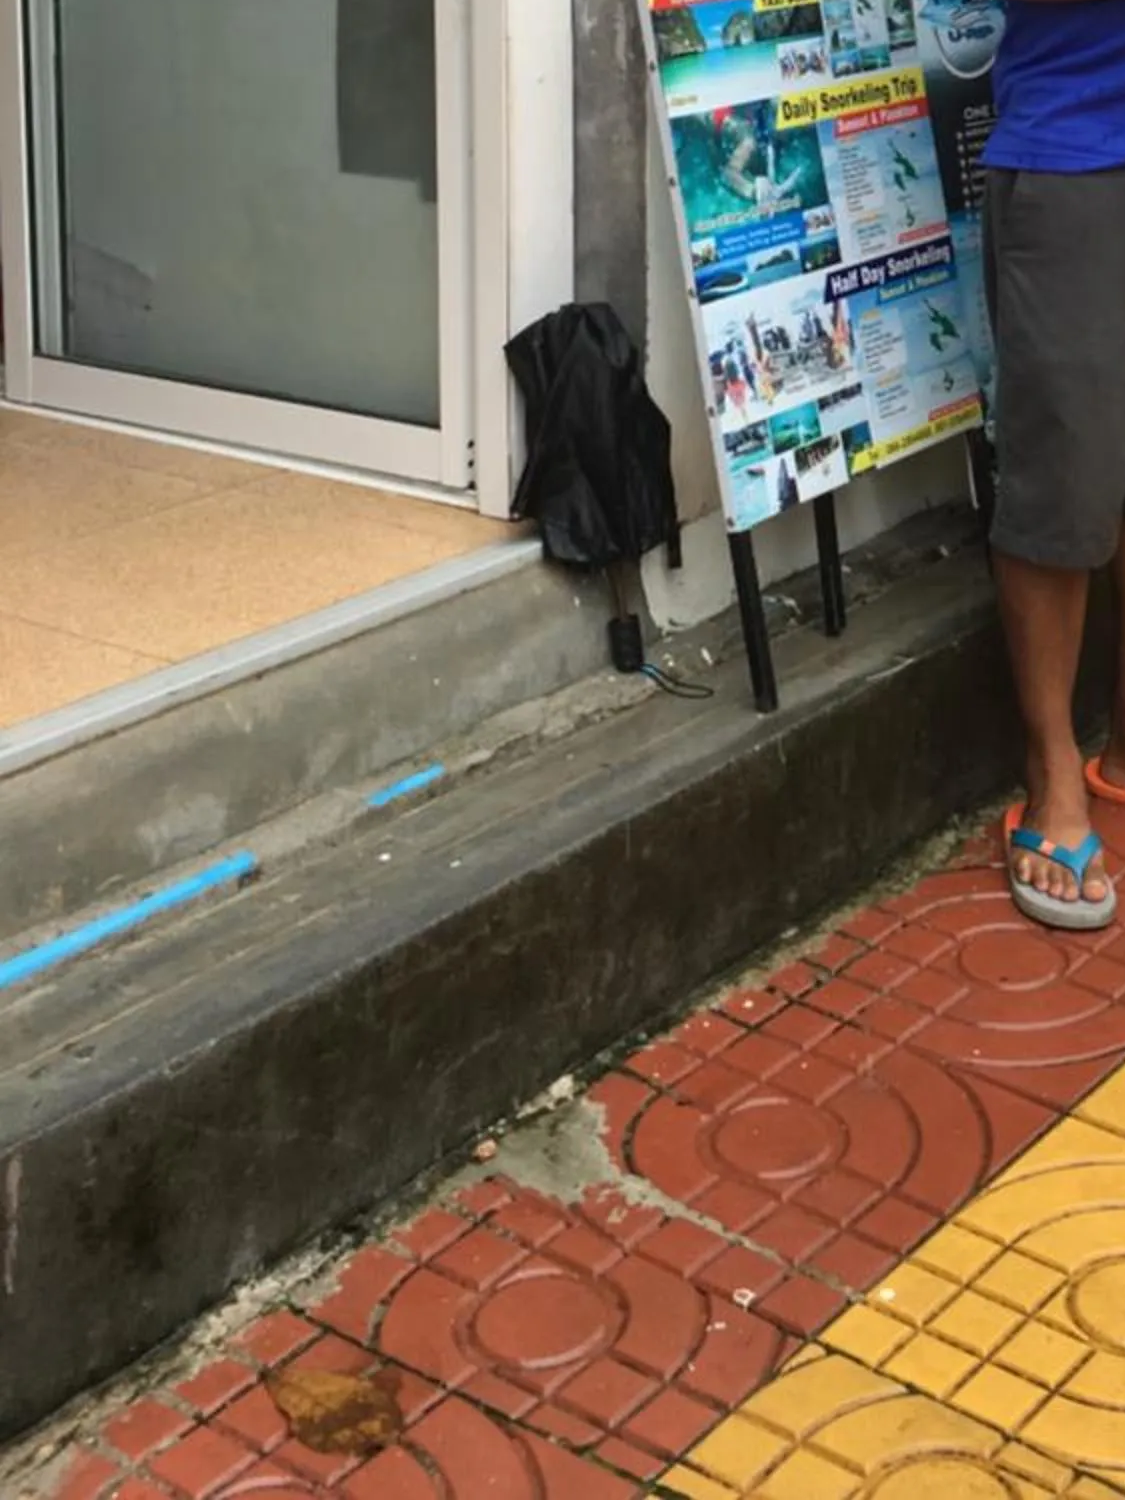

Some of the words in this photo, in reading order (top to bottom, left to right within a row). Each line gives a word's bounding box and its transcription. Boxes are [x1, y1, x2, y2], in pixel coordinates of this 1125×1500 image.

[781, 97, 819, 122] Daily
[820, 82, 889, 112] Snorkeling
[892, 76, 918, 100] Trip
[830, 271, 859, 296] Half
[860, 264, 887, 289] Day
